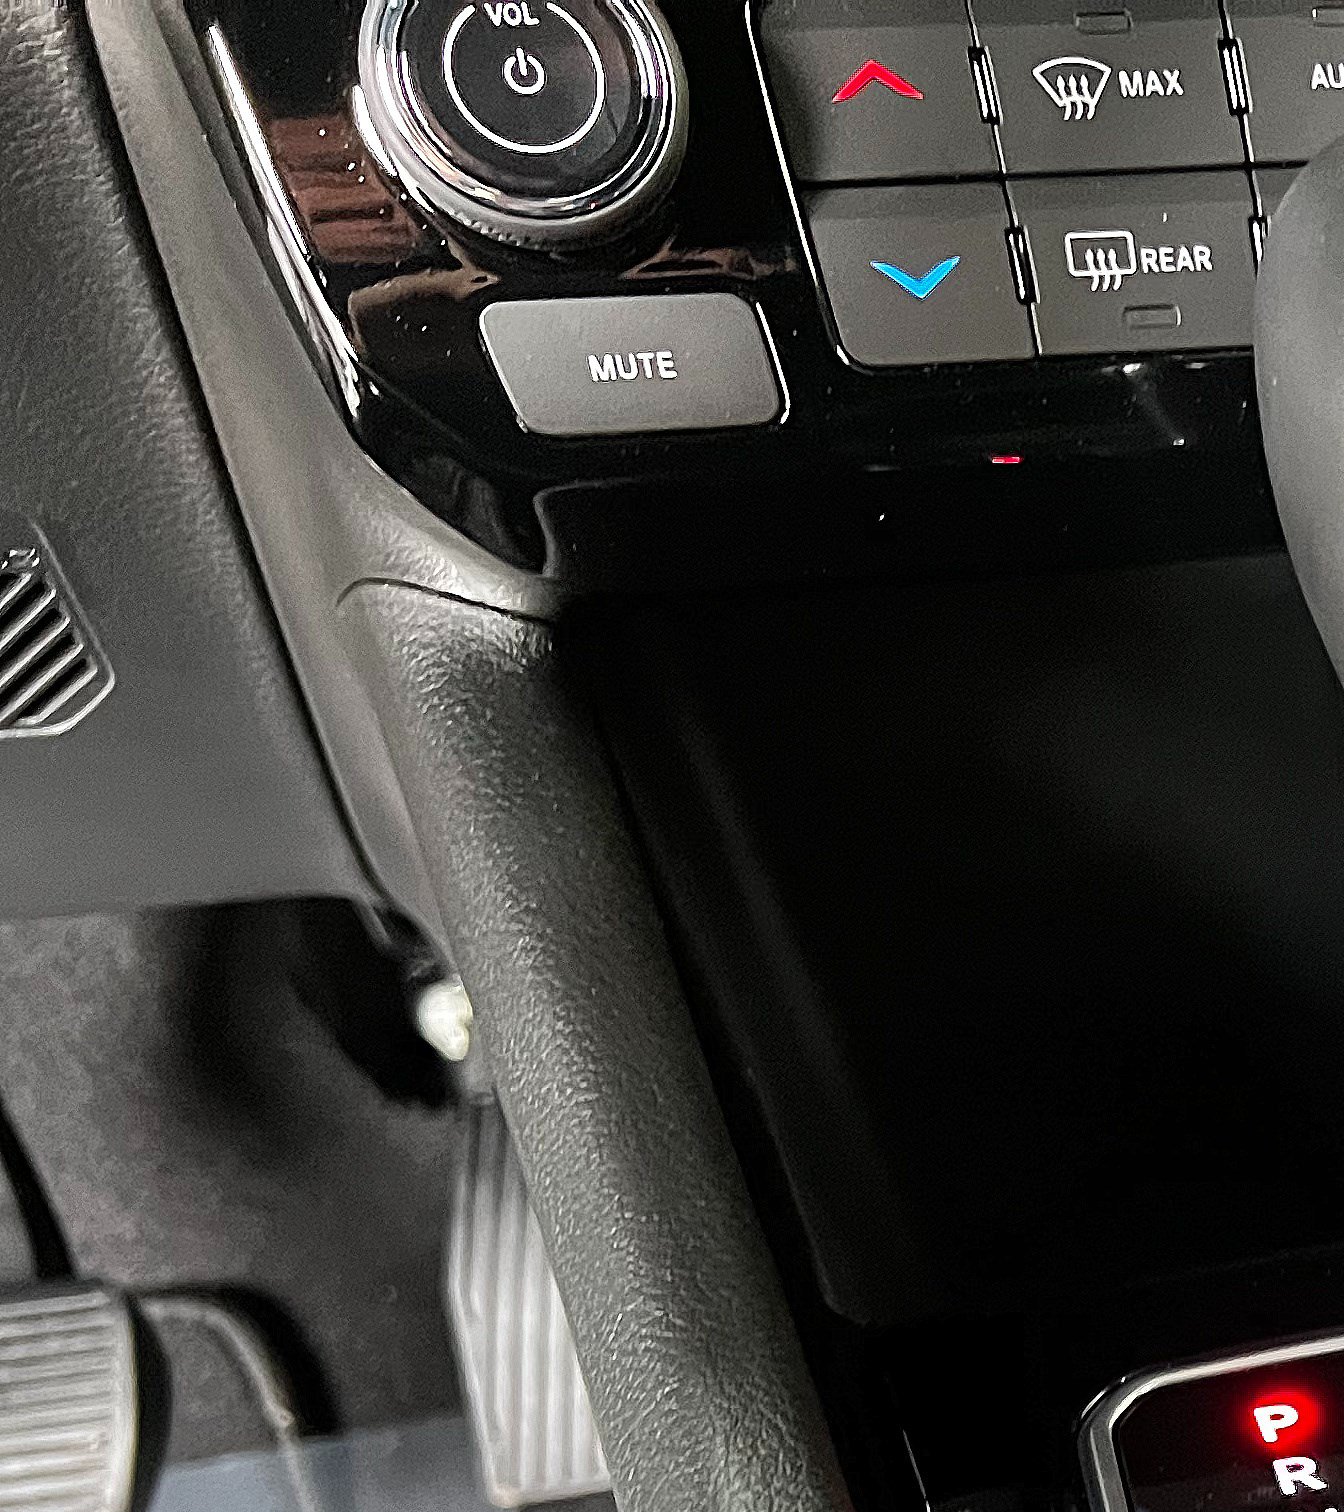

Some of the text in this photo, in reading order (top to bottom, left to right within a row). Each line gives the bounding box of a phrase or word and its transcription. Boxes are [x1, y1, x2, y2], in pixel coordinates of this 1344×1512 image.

[484, 2, 540, 27] VOL
[1118, 69, 1184, 98] MAX
[1140, 246, 1213, 273] REAR
[587, 350, 678, 382] MUTE
[1253, 1404, 1299, 1443] P
[1273, 1456, 1328, 1496] R
